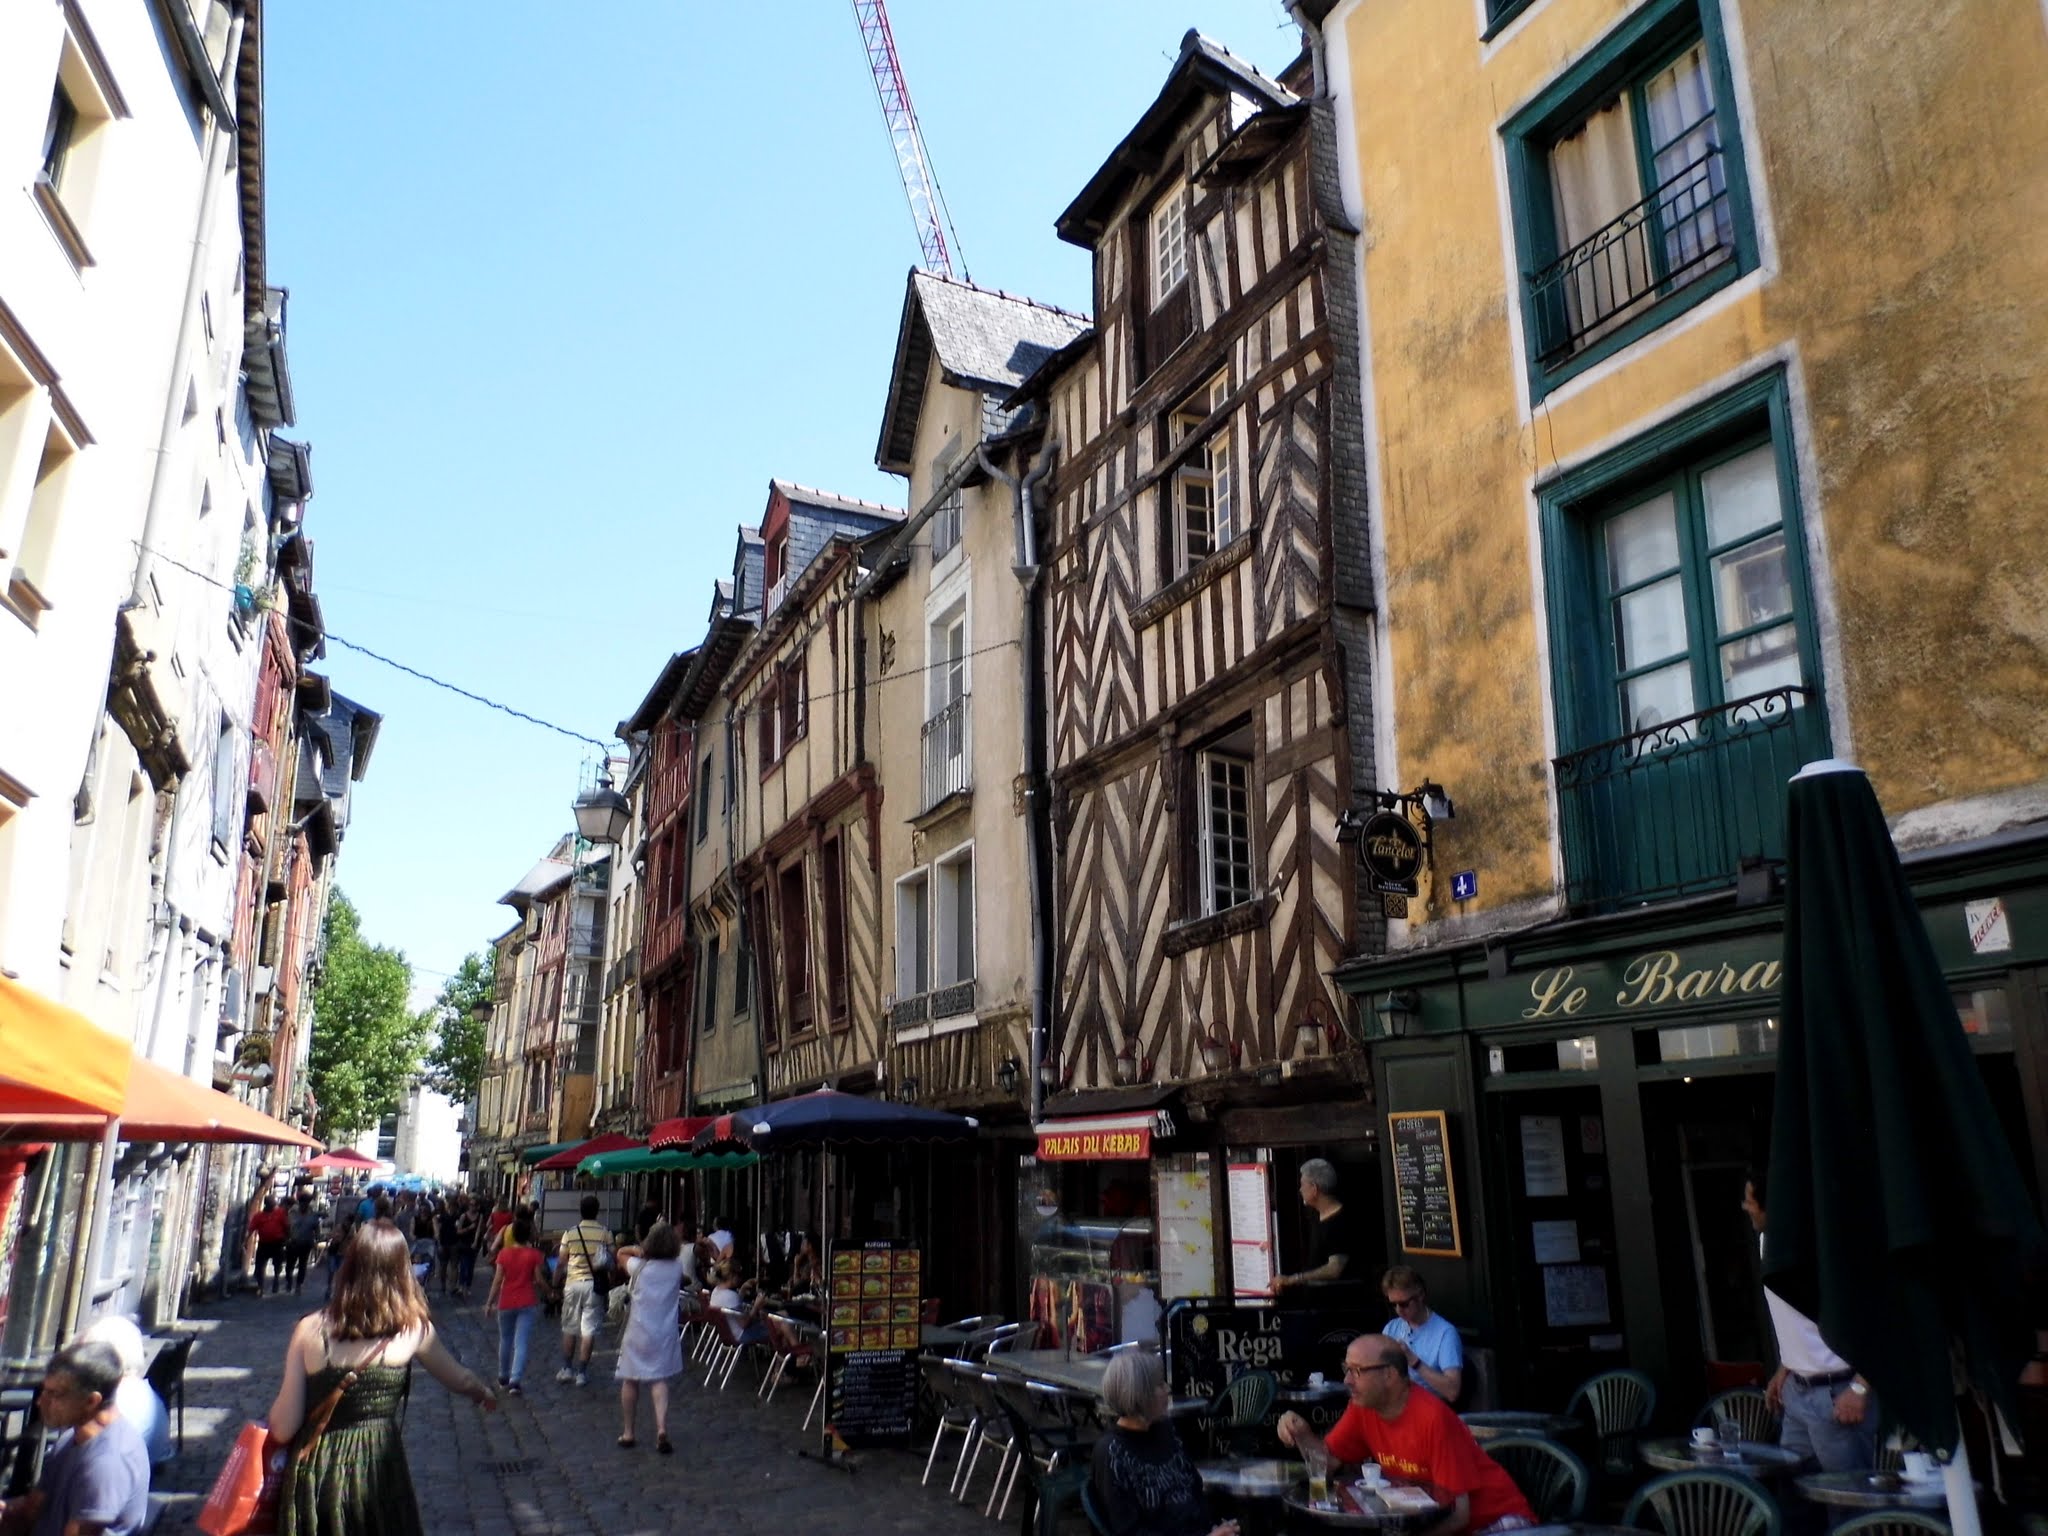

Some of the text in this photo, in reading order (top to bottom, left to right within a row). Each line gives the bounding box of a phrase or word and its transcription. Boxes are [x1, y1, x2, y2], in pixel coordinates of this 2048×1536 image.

[1456, 875, 1468, 895] 4
[1971, 904, 2002, 949] LICENCE
[1521, 950, 1783, 1019] Le Bara
[1044, 1133, 1141, 1156] PALAIS DU KEBAB
[864, 1240, 892, 1249] BURGERS
[1257, 1310, 1282, 1332] Le
[1216, 1328, 1283, 1367] Réga
[848, 1357, 864, 1366] PAIN
[1184, 1375, 1215, 1398] des
